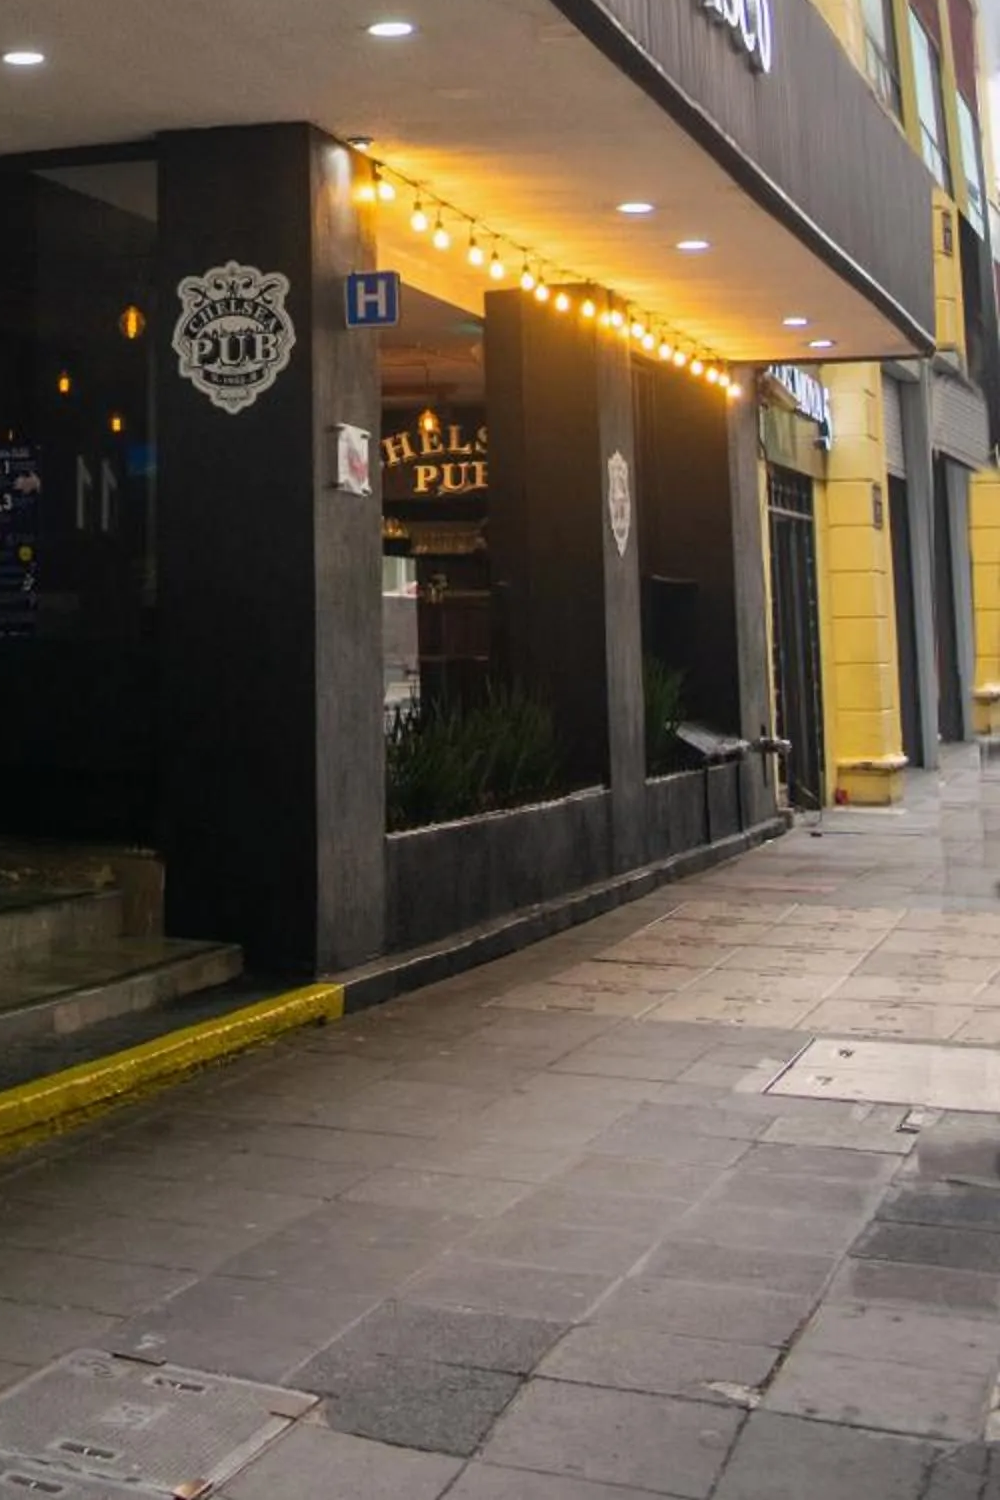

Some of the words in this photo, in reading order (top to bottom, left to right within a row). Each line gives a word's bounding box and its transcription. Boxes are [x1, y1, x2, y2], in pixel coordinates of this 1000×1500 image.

[356, 280, 386, 318] H
[188, 300, 279, 333] CHELSEA
[190, 334, 279, 368] PUB
